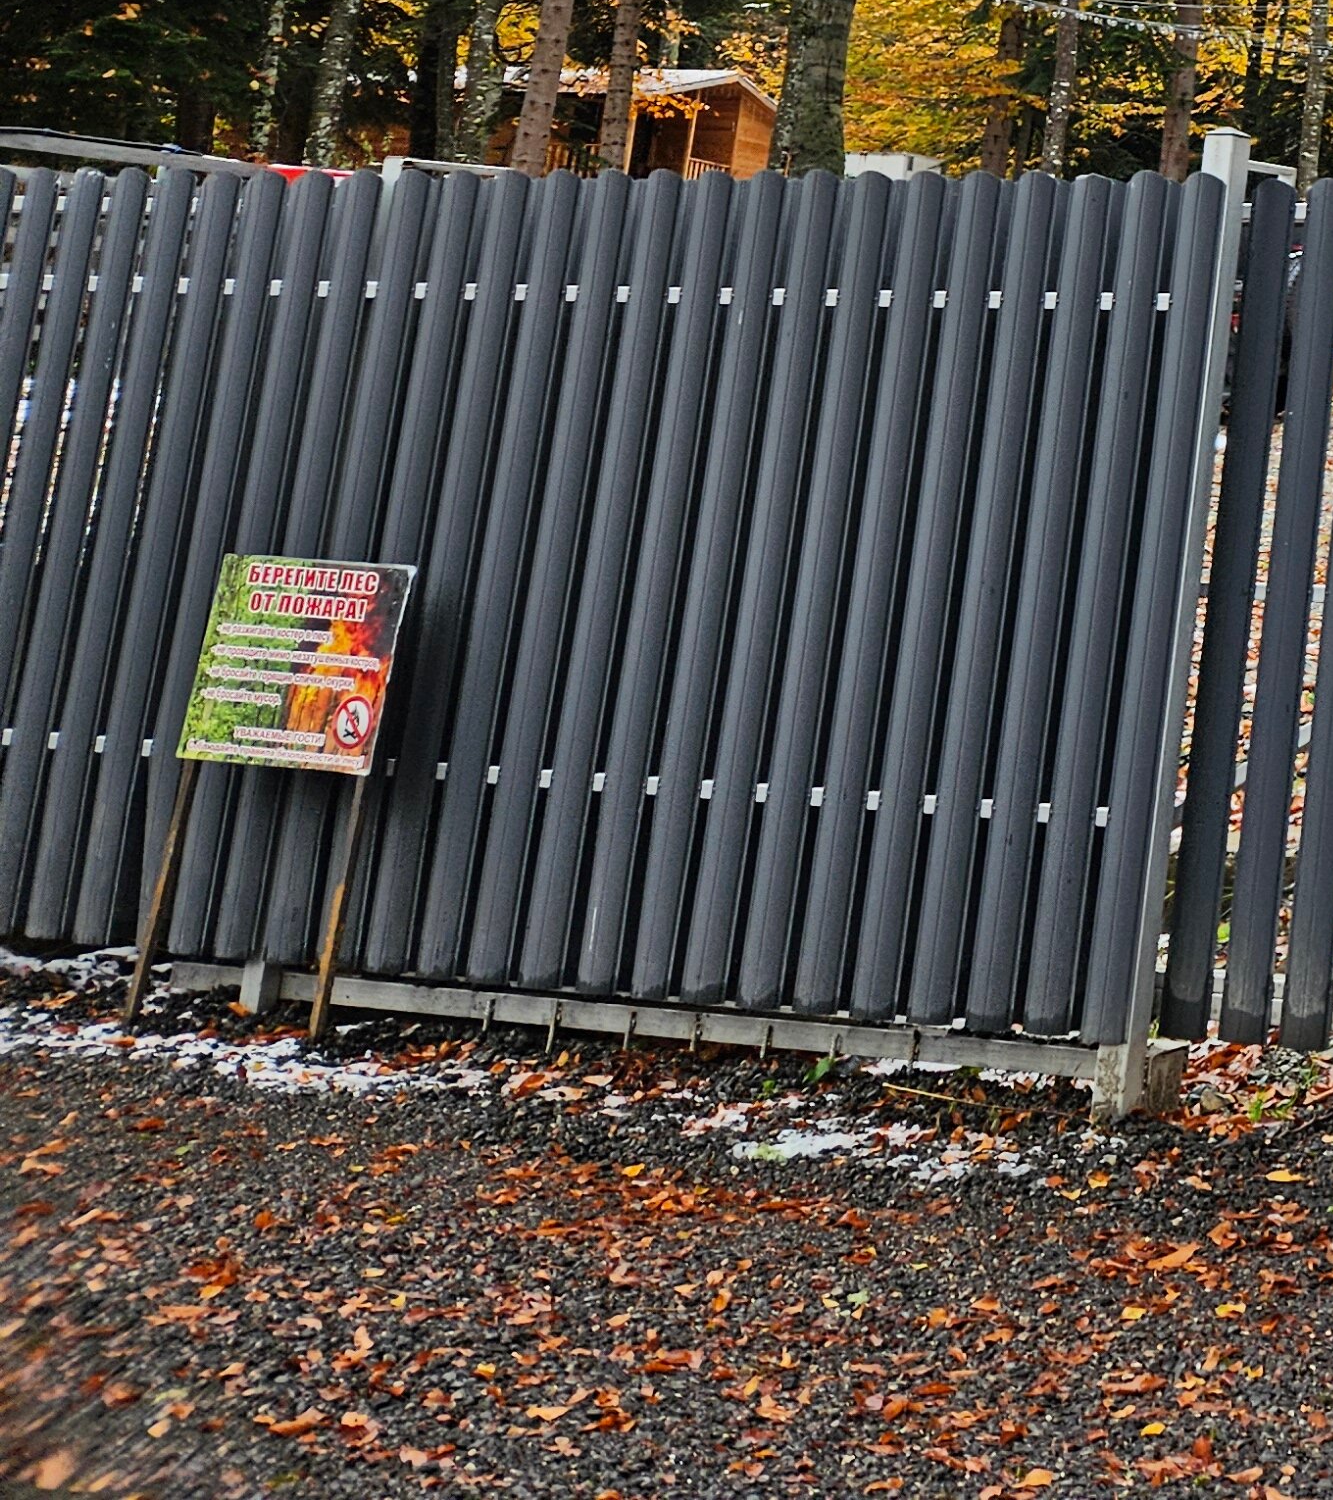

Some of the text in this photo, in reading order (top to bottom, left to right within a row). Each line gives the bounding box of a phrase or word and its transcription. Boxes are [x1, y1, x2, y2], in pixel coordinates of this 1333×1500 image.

[248, 564, 378, 594] БЕРЕГИТЕ ЛЕС
[249, 592, 367, 621] ОТ ПОЖАРА!
[233, 726, 291, 741] УВАЖАЕМЫЕ
